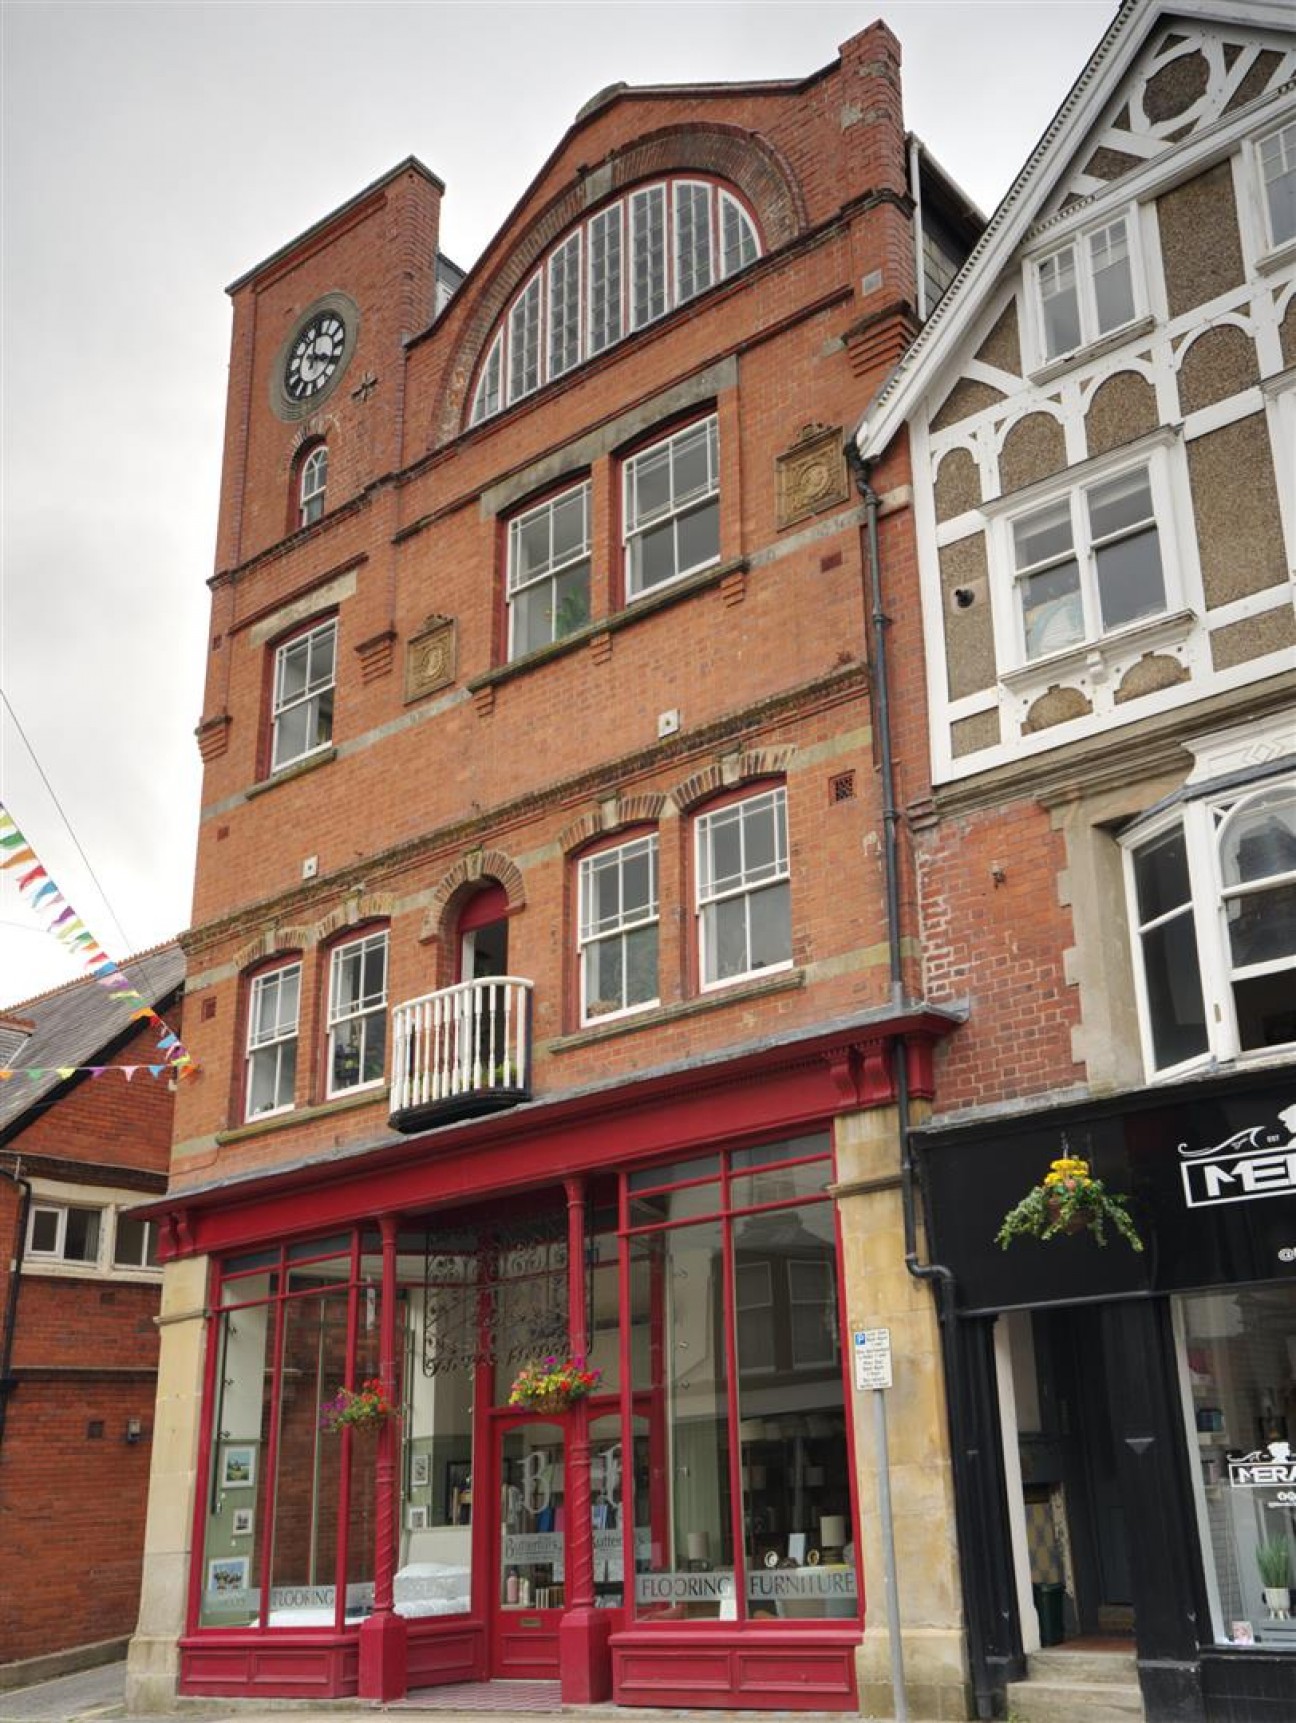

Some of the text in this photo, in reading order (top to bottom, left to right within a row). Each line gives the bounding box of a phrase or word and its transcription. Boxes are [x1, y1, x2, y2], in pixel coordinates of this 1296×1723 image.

[1204, 1152, 1296, 1197] ME
[642, 1572, 855, 1597] FLOORING FURNITURE
[271, 1588, 334, 1608] FLOORING
